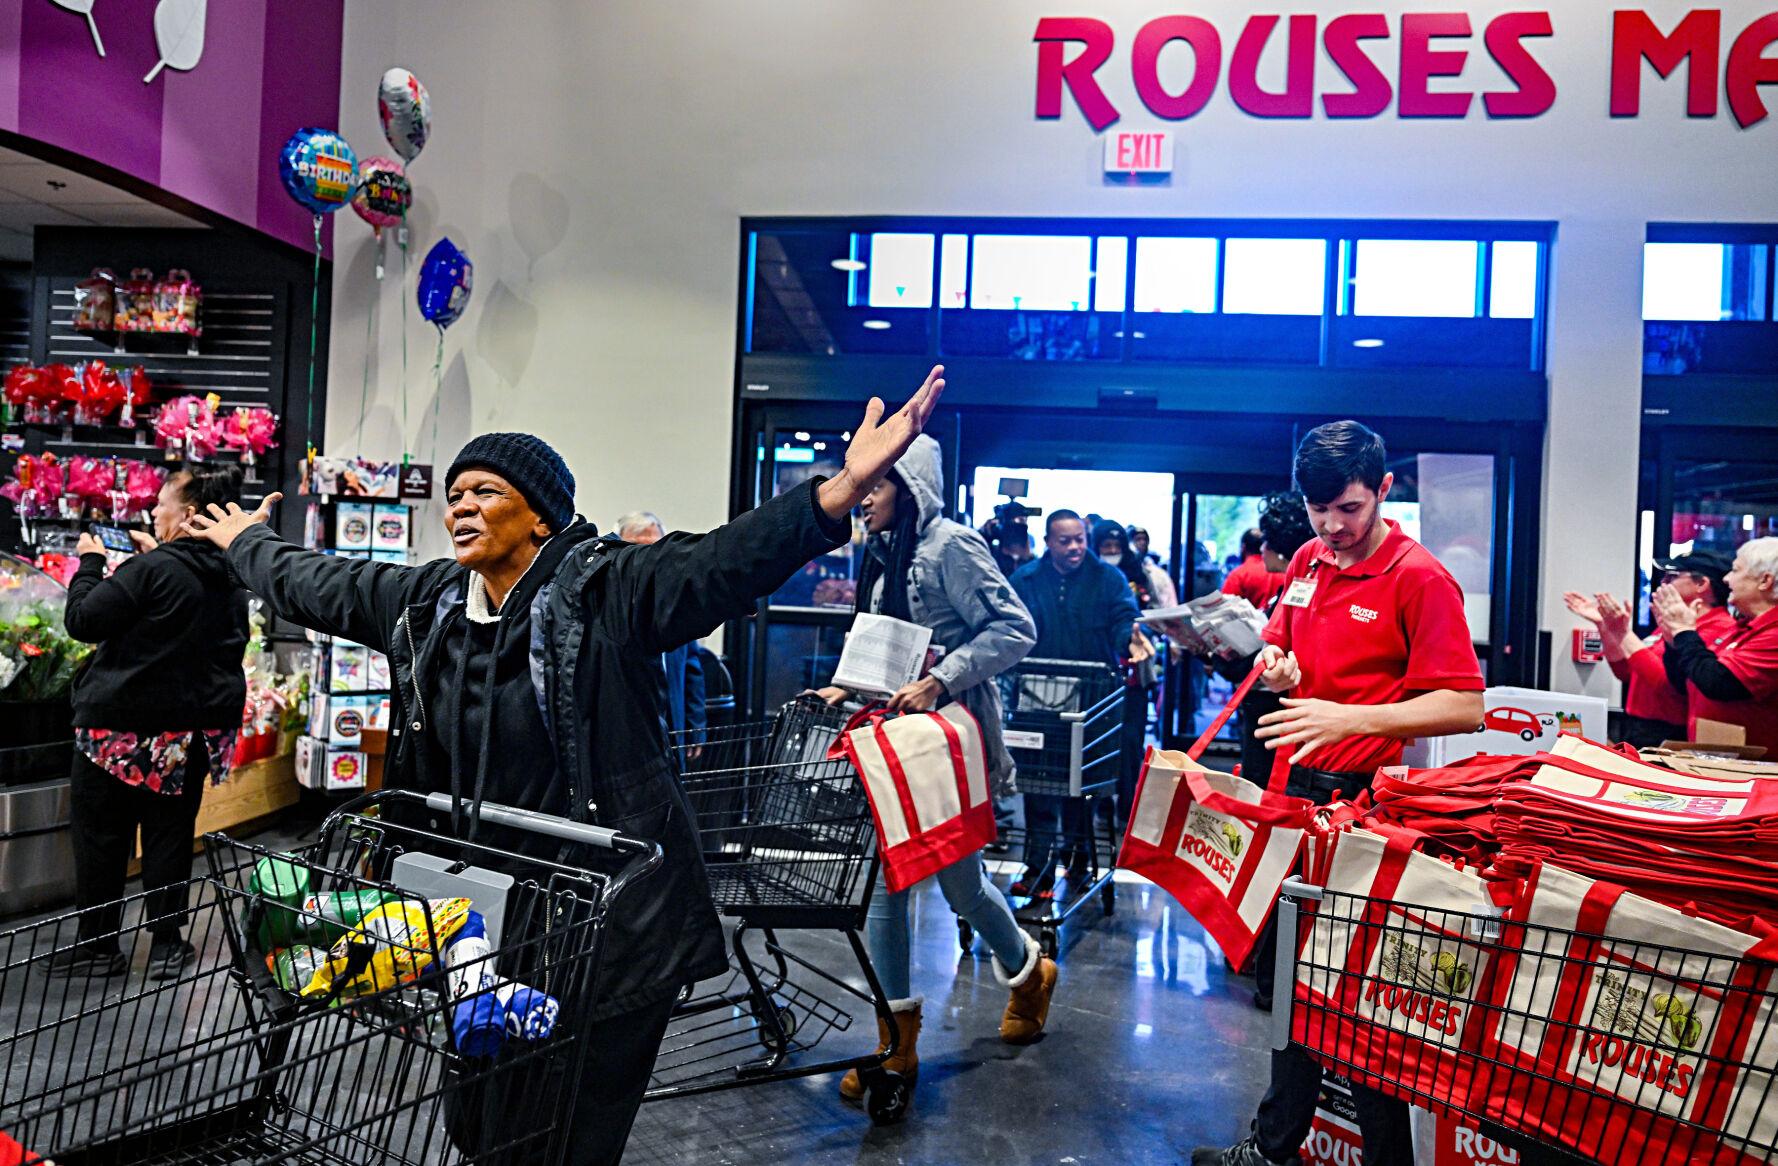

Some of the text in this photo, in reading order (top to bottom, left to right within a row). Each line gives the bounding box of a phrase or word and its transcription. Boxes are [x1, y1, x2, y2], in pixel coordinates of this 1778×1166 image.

[1033, 11, 1557, 129] ROUSES
[1116, 133, 1165, 168] EXIT
[1349, 604, 1378, 620] ROUSES
[1181, 833, 1236, 884] ROUSES
[1364, 974, 1462, 1037] ROUSES
[1578, 1024, 1694, 1099] ROUSES
[1455, 1126, 1520, 1165] ROU
